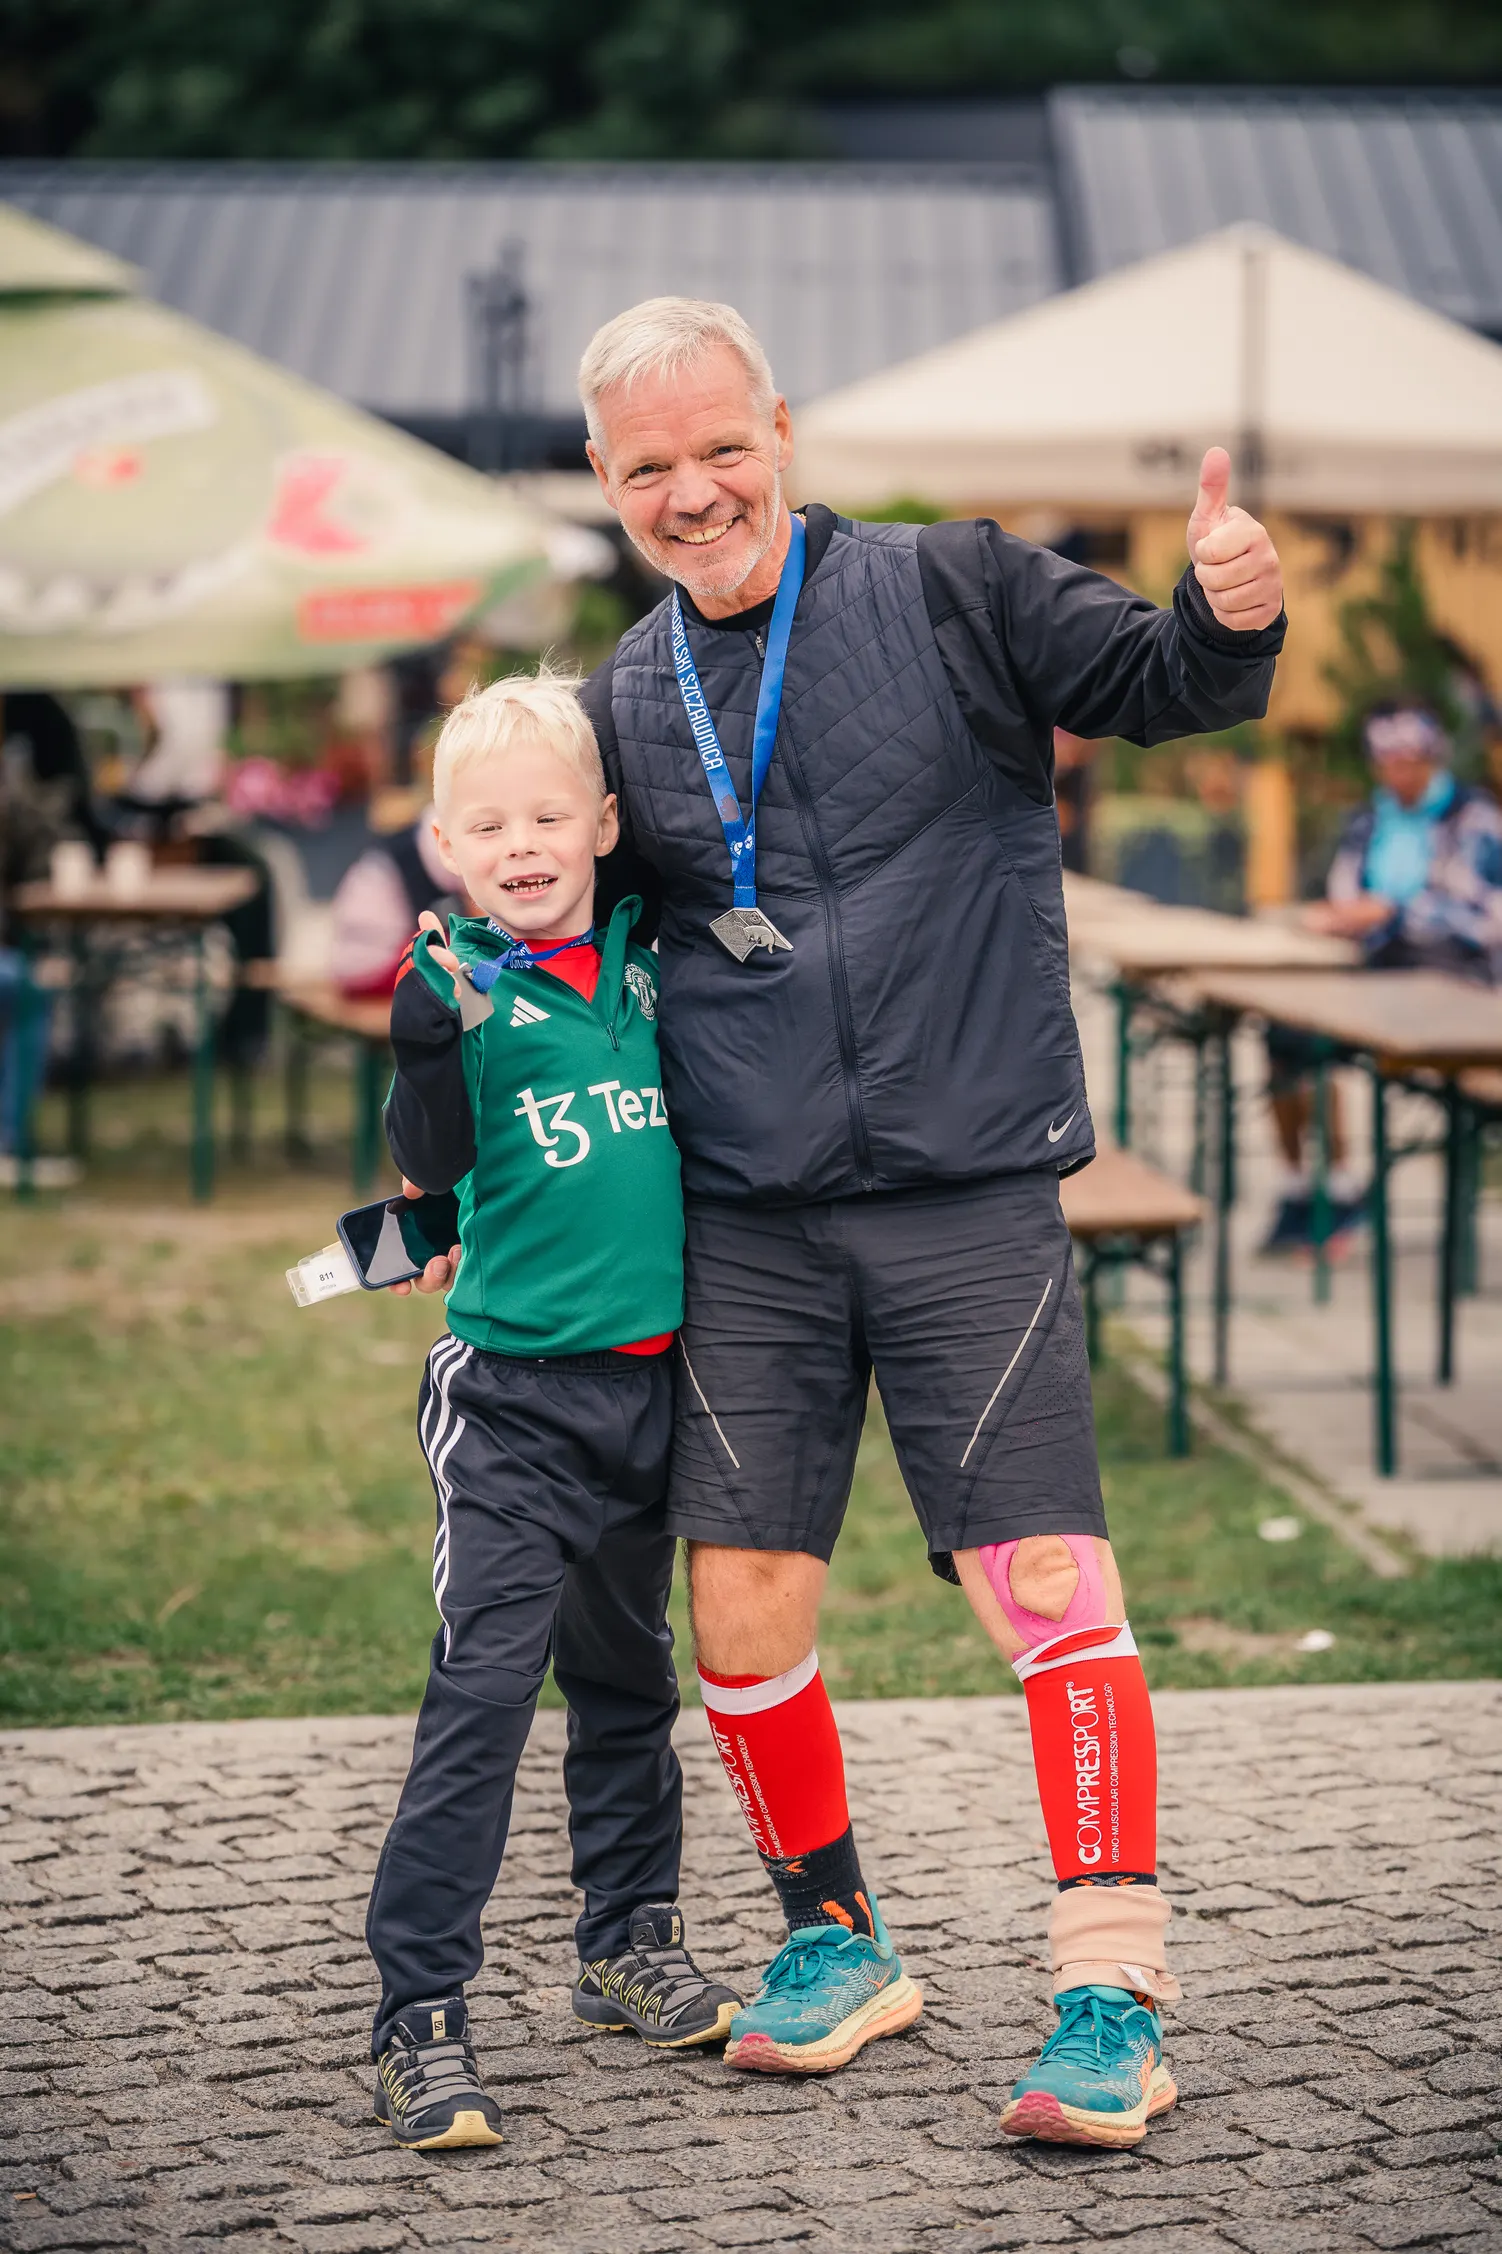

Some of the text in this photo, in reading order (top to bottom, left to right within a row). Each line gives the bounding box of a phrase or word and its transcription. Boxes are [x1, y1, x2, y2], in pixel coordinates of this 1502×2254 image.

[679, 673, 723, 771] SZCZAWNICA
[587, 1080, 669, 1133] Tez
[319, 1271, 334, 1282] 811
[1103, 1682, 1117, 1729] TECHNOLOGY
[736, 1734, 755, 1772] TECHNOLOGY
[1109, 1730, 1120, 1787] COMPRESSION
[748, 1771, 769, 1815] COMPRESSION
